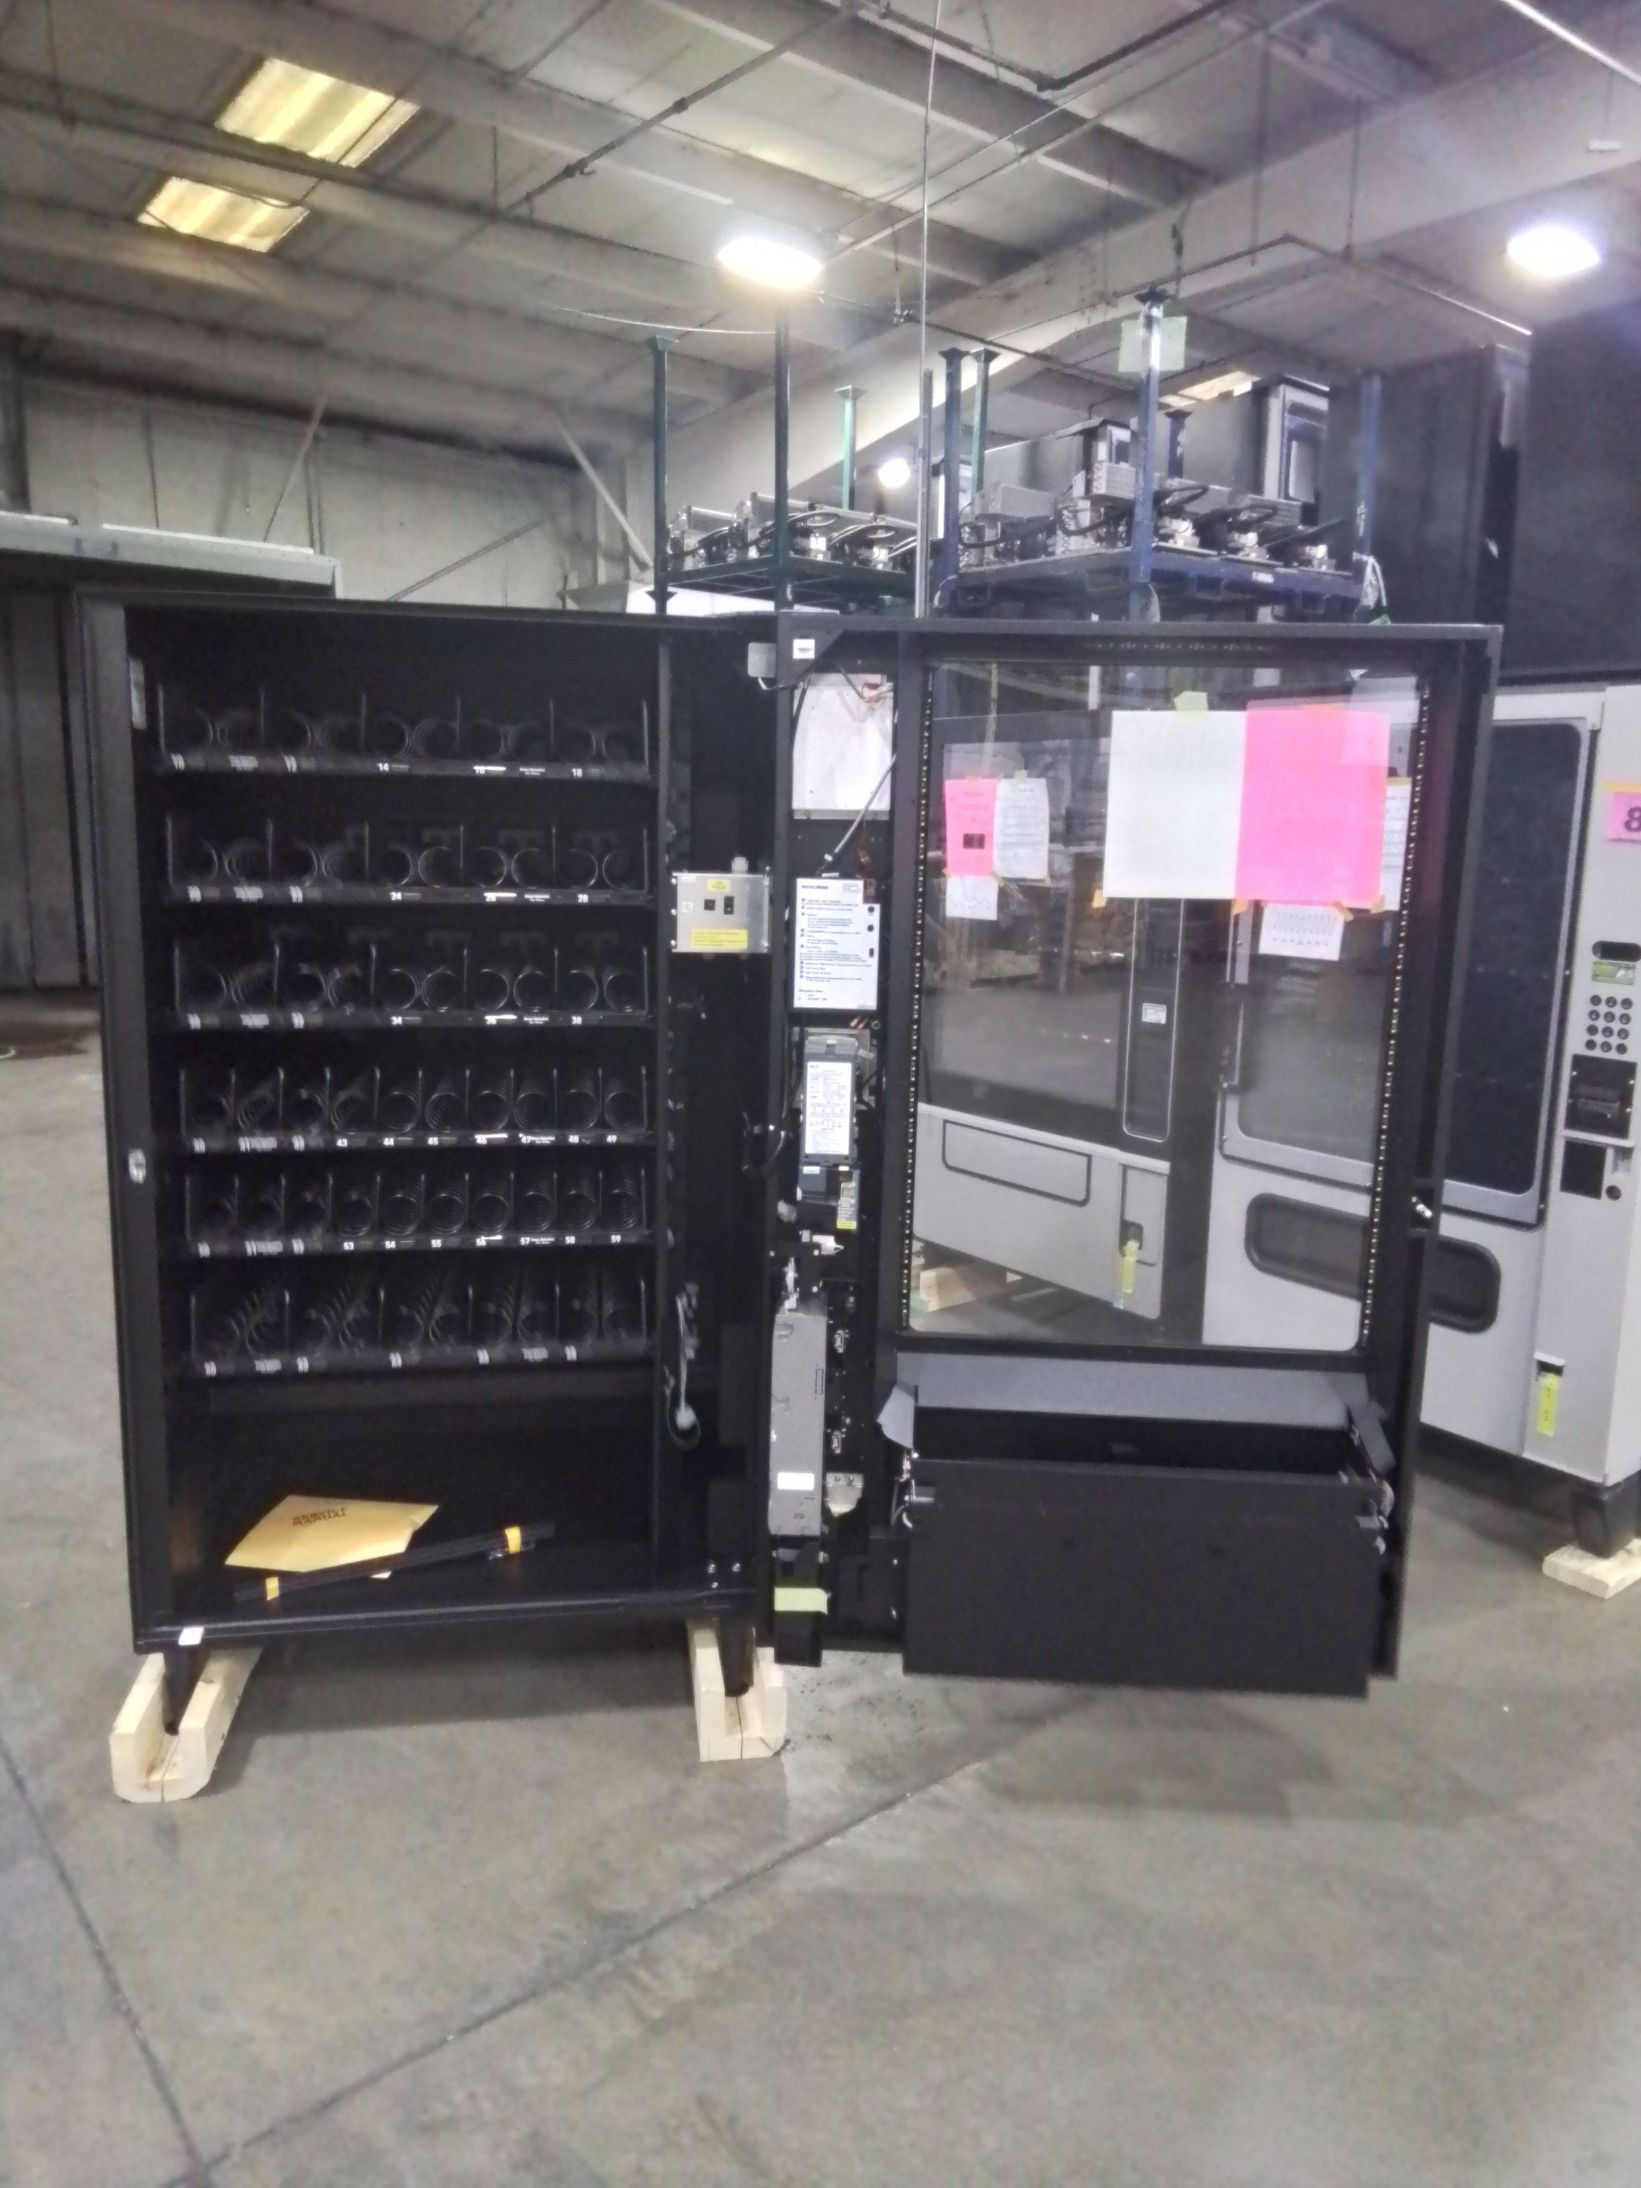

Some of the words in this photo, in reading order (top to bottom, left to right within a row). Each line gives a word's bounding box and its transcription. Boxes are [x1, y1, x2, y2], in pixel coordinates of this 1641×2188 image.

[1624, 807, 1641, 832] 8
[390, 891, 402, 901] 24
[391, 1016, 403, 1025] 34
[383, 1137, 395, 1146] 44
[428, 1136, 439, 1146] 45
[606, 1134, 617, 1143] 49
[431, 1239, 442, 1248] 55
